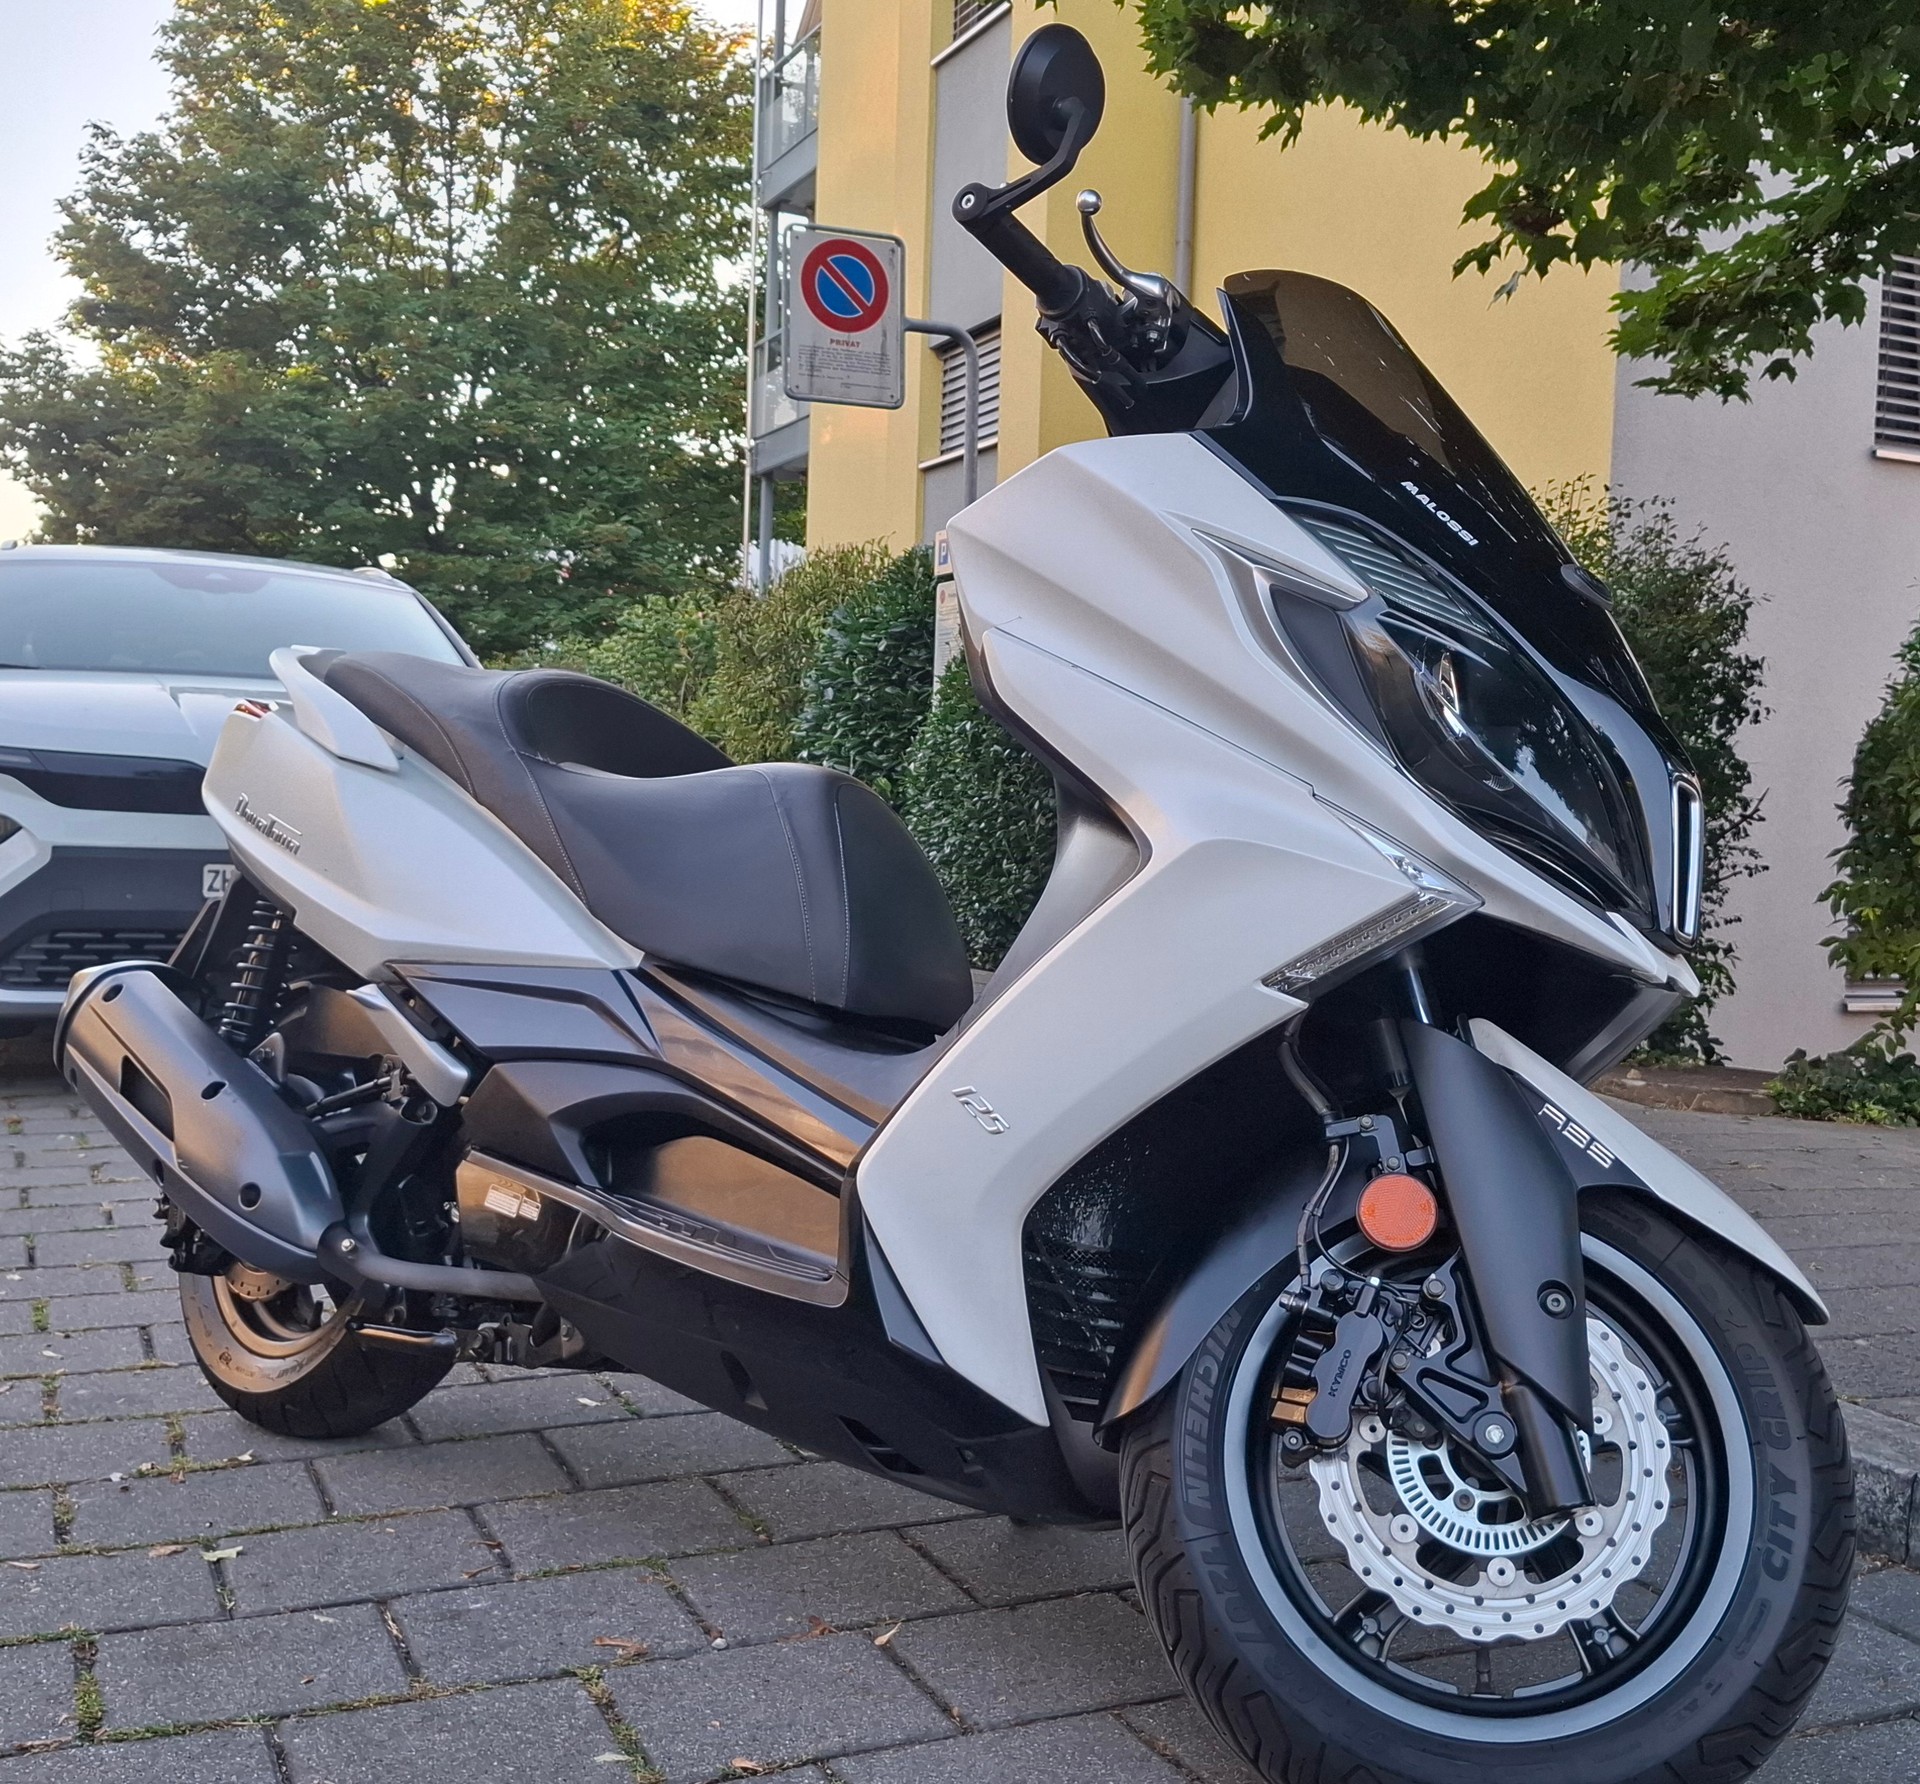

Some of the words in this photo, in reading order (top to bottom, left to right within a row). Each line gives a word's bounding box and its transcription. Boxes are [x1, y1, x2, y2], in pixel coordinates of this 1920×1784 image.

[829, 337, 862, 349] PRIVAT
[1400, 481, 1479, 546] MALOSSI
[940, 542, 947, 564] P
[951, 1085, 1011, 1136] 125
[1537, 1102, 1616, 1169] ABS
[1328, 1349, 1351, 1398] KYMCO
[1735, 1343, 1792, 1451] GRIP
[1184, 1306, 1243, 1510] MICHELIN
[1761, 1462, 1798, 1582] CITY
